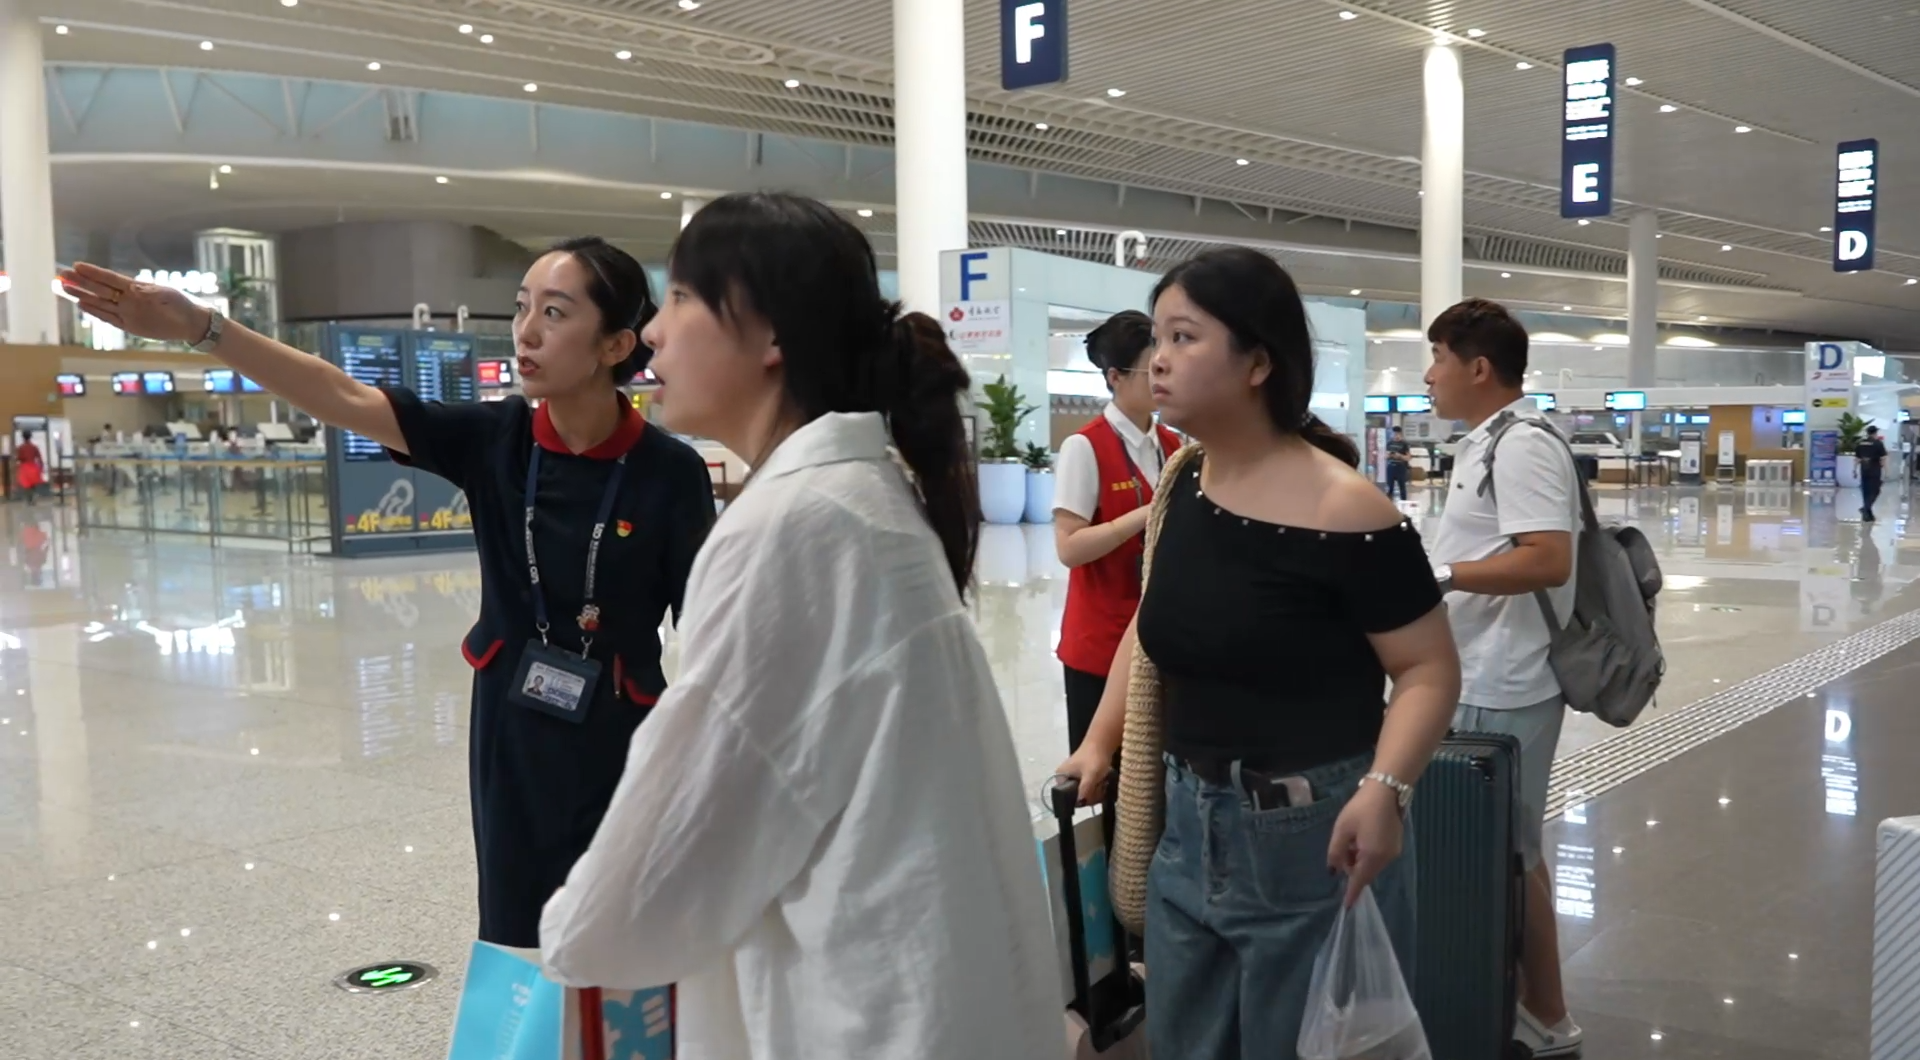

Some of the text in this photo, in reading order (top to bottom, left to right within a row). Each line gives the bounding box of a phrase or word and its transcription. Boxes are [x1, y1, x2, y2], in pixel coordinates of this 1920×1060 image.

[1015, 2, 1045, 64] F
[1572, 162, 1599, 203] E
[1838, 230, 1868, 261] D
[960, 252, 988, 301] F
[1818, 343, 1843, 370] D
[357, 511, 380, 532] 4F
[431, 509, 453, 529] 4F
